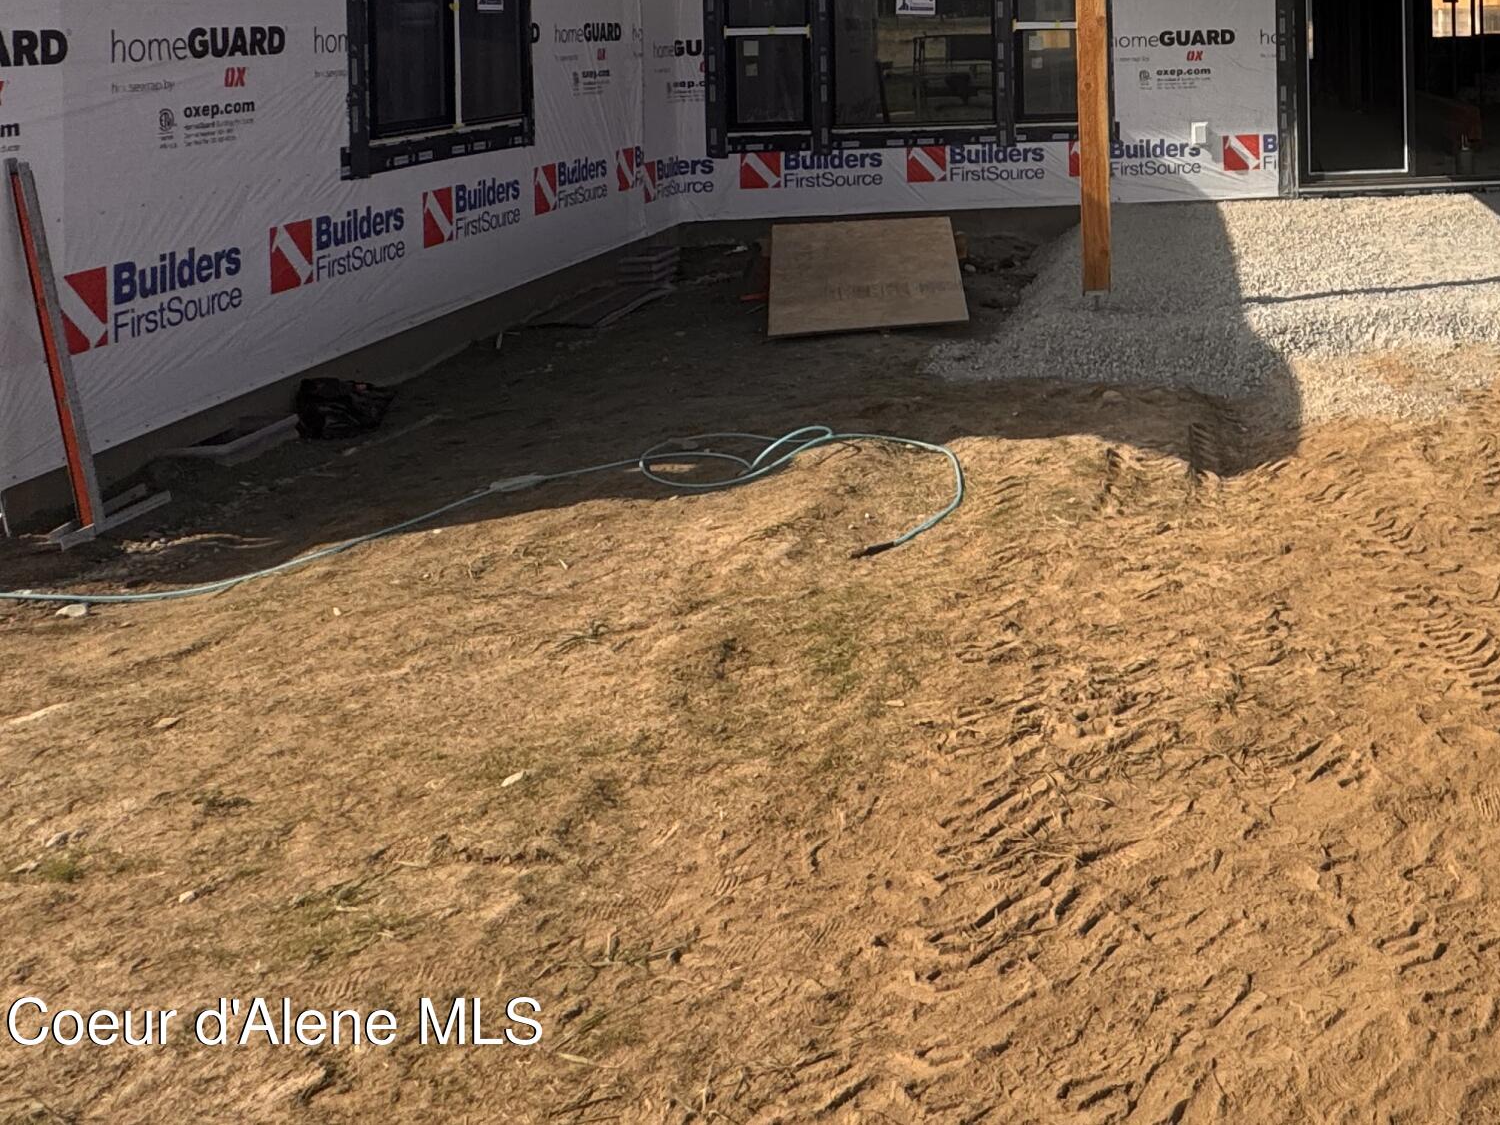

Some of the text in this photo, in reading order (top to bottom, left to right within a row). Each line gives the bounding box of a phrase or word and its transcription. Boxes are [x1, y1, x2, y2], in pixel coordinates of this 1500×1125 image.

[111, 26, 286, 63] homeGUARD
[554, 23, 622, 44] homeGUARD
[652, 39, 703, 59] homeGU
[1186, 50, 1203, 62] OX
[224, 67, 246, 88] OX
[184, 100, 256, 119] oxep.com
[784, 150, 882, 172] Builders
[950, 144, 1045, 163] Builders
[558, 158, 607, 186] Builders
[657, 155, 714, 180] Builders
[784, 170, 883, 188] FirstSource
[950, 164, 1045, 184] FirstSource
[1110, 161, 1201, 176] FirstSource
[455, 177, 520, 213] Builders
[558, 182, 608, 210] FirstSource
[316, 206, 405, 251] Builders
[455, 207, 521, 241] FirstSource
[316, 240, 405, 282] FirstSource
[113, 246, 242, 305] Builders
[113, 287, 243, 344] FirstSource
